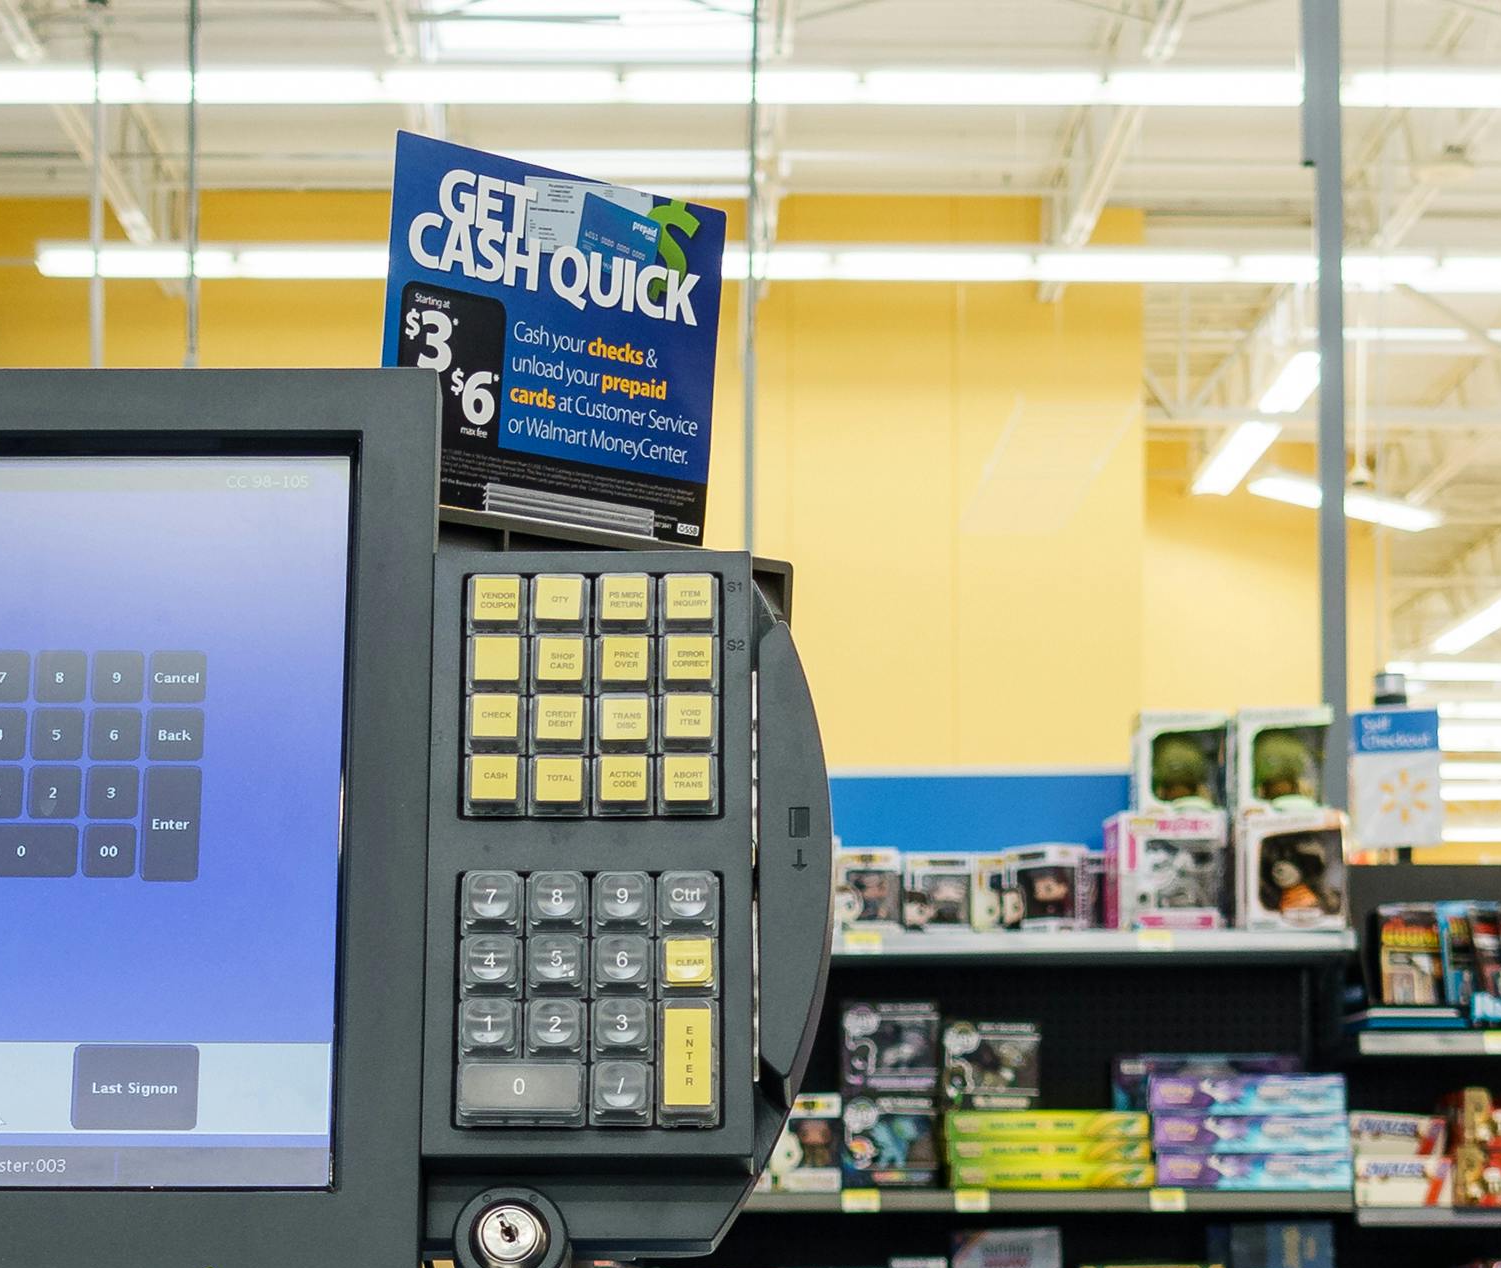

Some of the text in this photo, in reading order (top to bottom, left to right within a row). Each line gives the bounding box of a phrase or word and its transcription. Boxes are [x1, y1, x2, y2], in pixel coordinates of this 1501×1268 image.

[439, 169, 538, 239] GET
[632, 221, 658, 237] prepaid
[408, 212, 700, 327] CASH QUICK
[415, 292, 443, 309] Starting
[514, 321, 658, 369] Cash your checks &
[512, 355, 667, 400] unload your prepaid
[510, 387, 698, 437] cards at Customer Service
[460, 426, 488, 438] max fee
[508, 417, 688, 465] or Walmart MoneyCenter.
[727, 582, 743, 593] S1
[481, 592, 516, 600] VENDOR
[551, 595, 569, 604] QTY
[680, 590, 701, 598] ITEM
[480, 601, 516, 609] COUPON
[610, 601, 643, 609] RETURN
[673, 599, 708, 608] INQUIRY
[727, 640, 745, 651] S2
[551, 652, 575, 661] SHOP
[613, 651, 640, 659] PRICE
[677, 650, 705, 658] ERROR
[550, 661, 575, 670] CARD
[614, 660, 638, 668] OVER
[672, 659, 709, 668] CORRECT
[54, 672, 65, 684] 8
[111, 672, 122, 684] 9
[153, 671, 201, 685] Cancel
[482, 711, 512, 719] CHECK
[545, 710, 577, 719] CREDIT
[612, 712, 641, 720] TRANS
[680, 709, 701, 717] VOID
[548, 719, 573, 728] DEBIT
[616, 721, 637, 729] DISC
[680, 717, 701, 726] ITEM
[51, 729, 62, 741] 5
[109, 729, 119, 741] 6
[158, 728, 192, 742] Back
[483, 771, 508, 780] CASH
[547, 774, 575, 782] TOTAL
[610, 770, 642, 779] ACTION
[673, 771, 703, 779] ABORT
[613, 780, 637, 788] CODE
[673, 780, 703, 789] TRANS
[48, 787, 58, 799] 2
[106, 787, 116, 799] 3
[151, 818, 190, 831] Enter
[16, 845, 26, 857] 0
[99, 845, 118, 857] 00
[486, 888, 497, 905] 7
[551, 889, 563, 905] 8
[616, 888, 629, 905] 9
[671, 887, 701, 902] Ctrl
[483, 952, 496, 967] 4
[550, 950, 562, 967] 5
[616, 951, 628, 967] 6
[676, 959, 705, 967] CLEAR
[484, 1015, 492, 1031] 1
[549, 1017, 562, 1032] 2
[616, 1015, 628, 1030] 3
[685, 1025, 694, 1086] ENTER
[92, 1081, 178, 1098] Last Signon
[512, 1078, 525, 1095] 0
